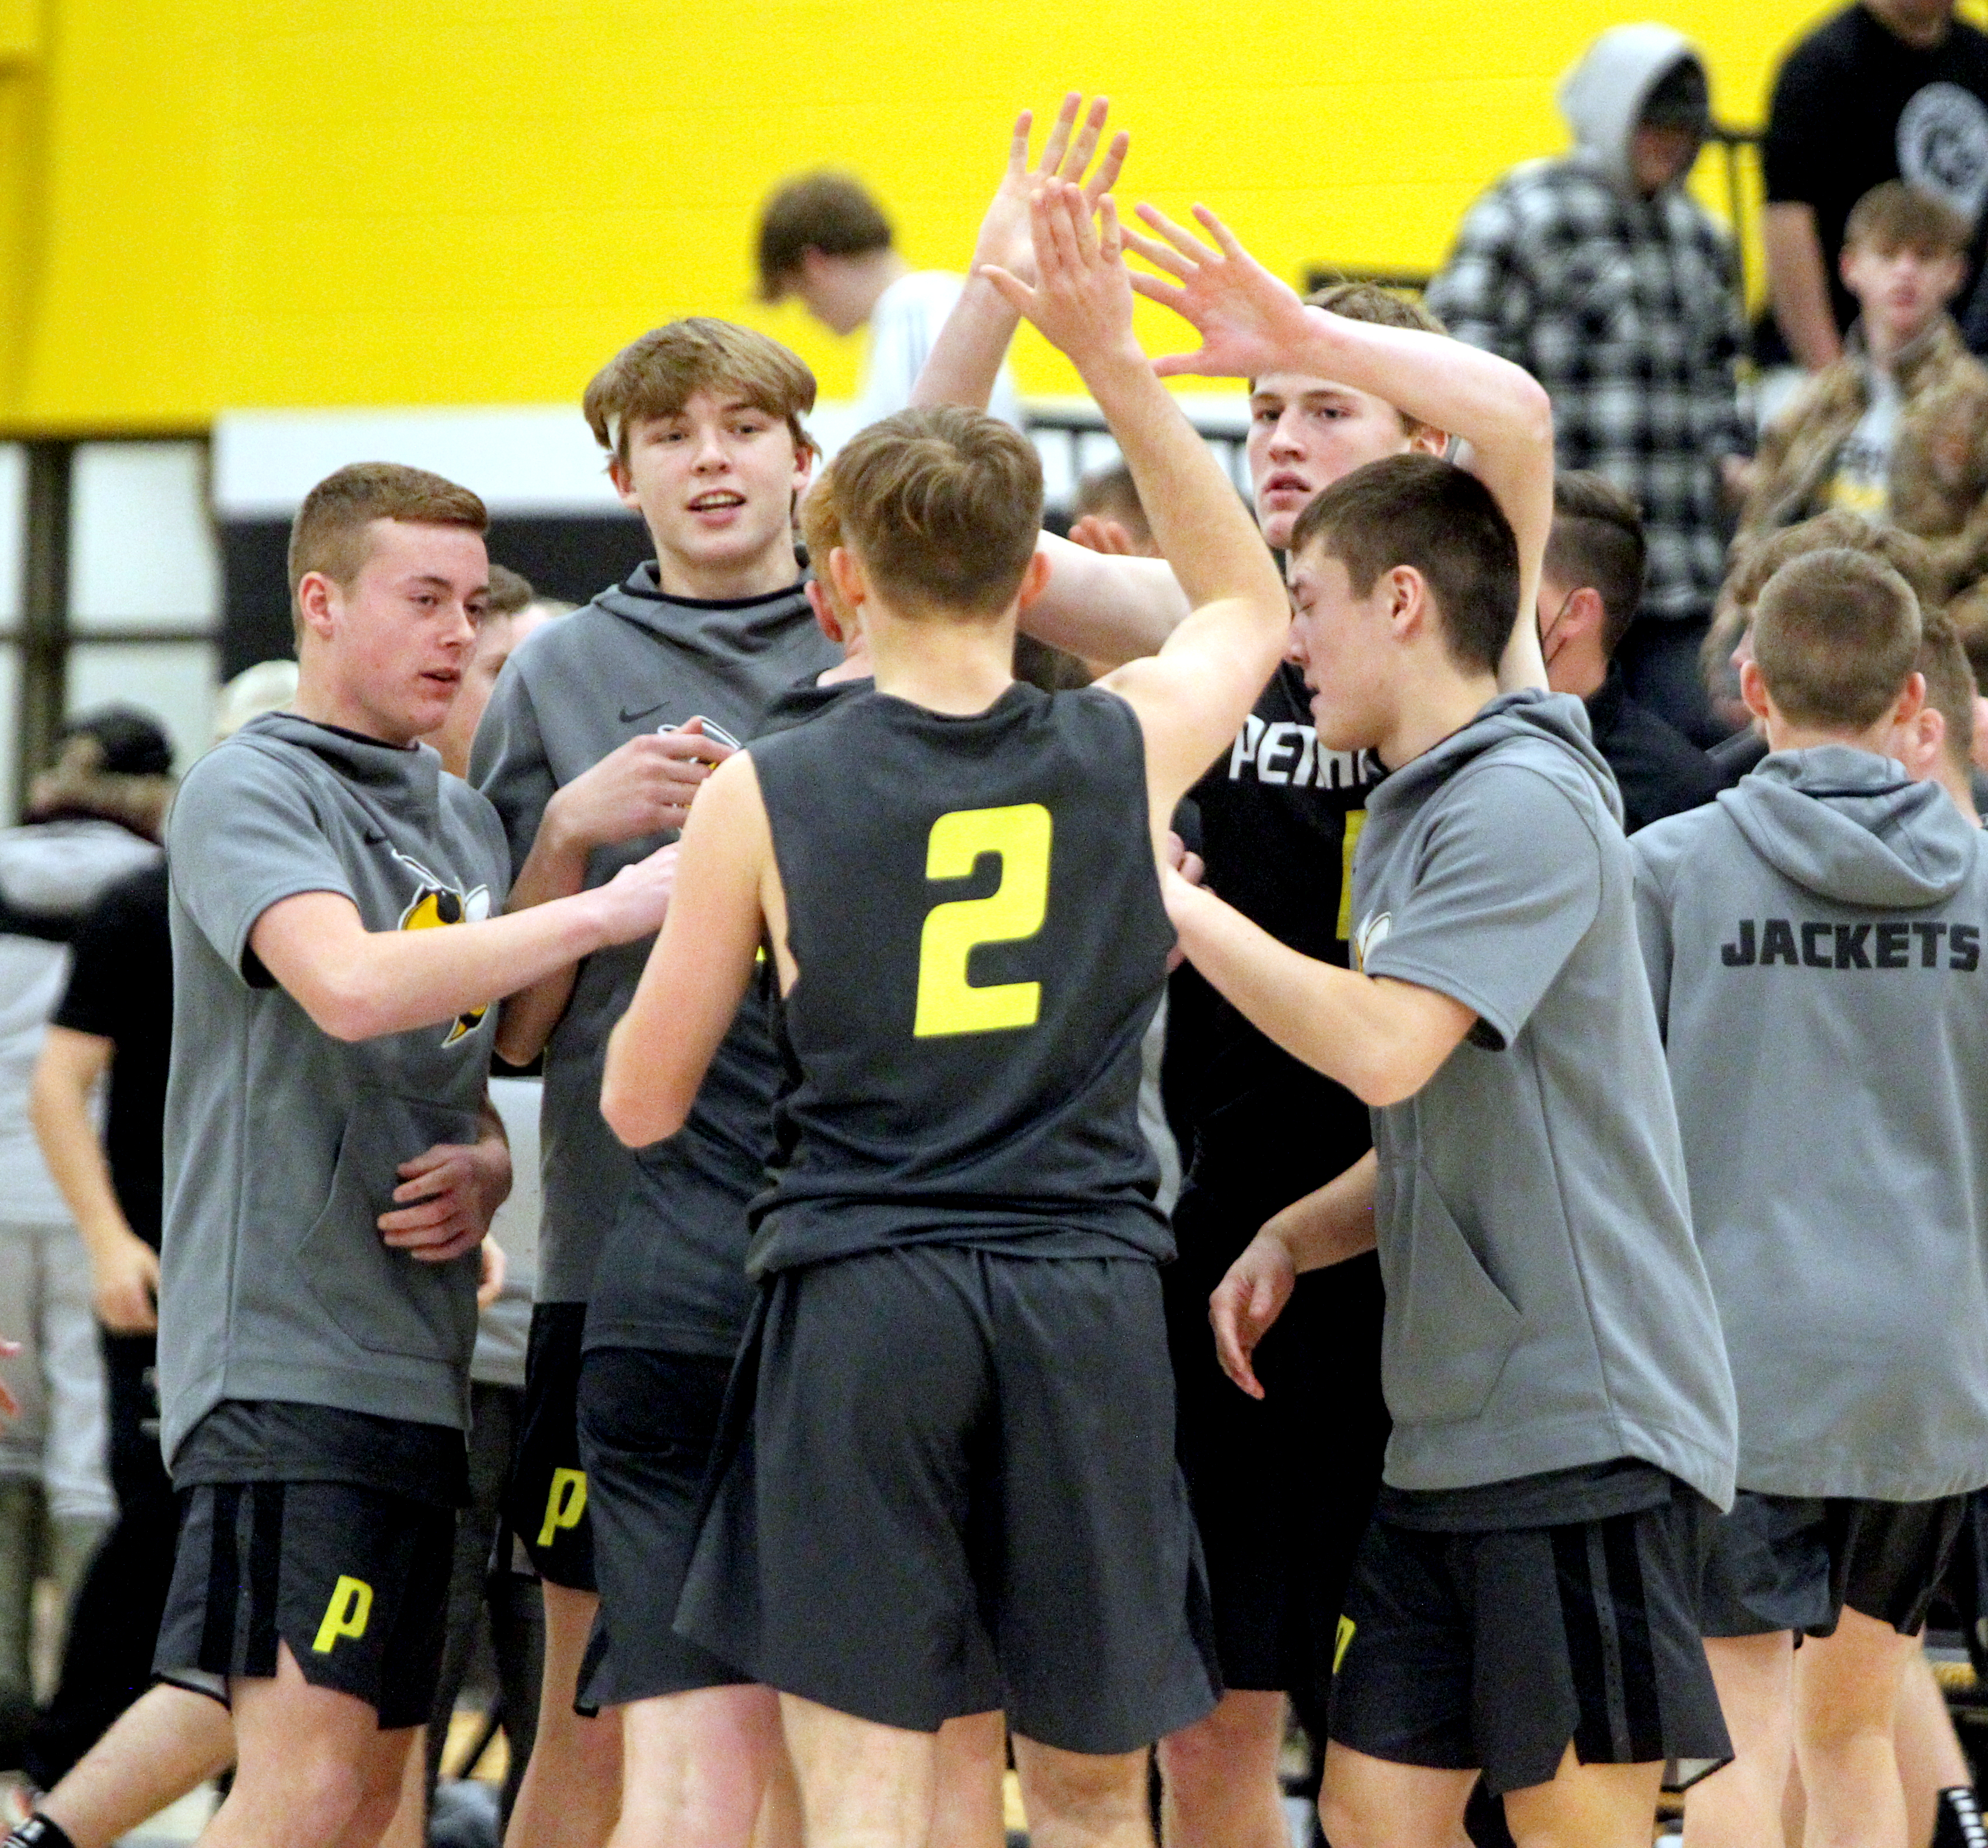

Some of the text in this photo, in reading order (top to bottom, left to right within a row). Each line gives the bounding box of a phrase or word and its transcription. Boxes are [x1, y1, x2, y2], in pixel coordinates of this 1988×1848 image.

[913, 802, 1052, 1037] 2
[1721, 918, 1980, 972] JACKETS
[537, 1467, 587, 1546] P
[312, 1575, 373, 1653] P
